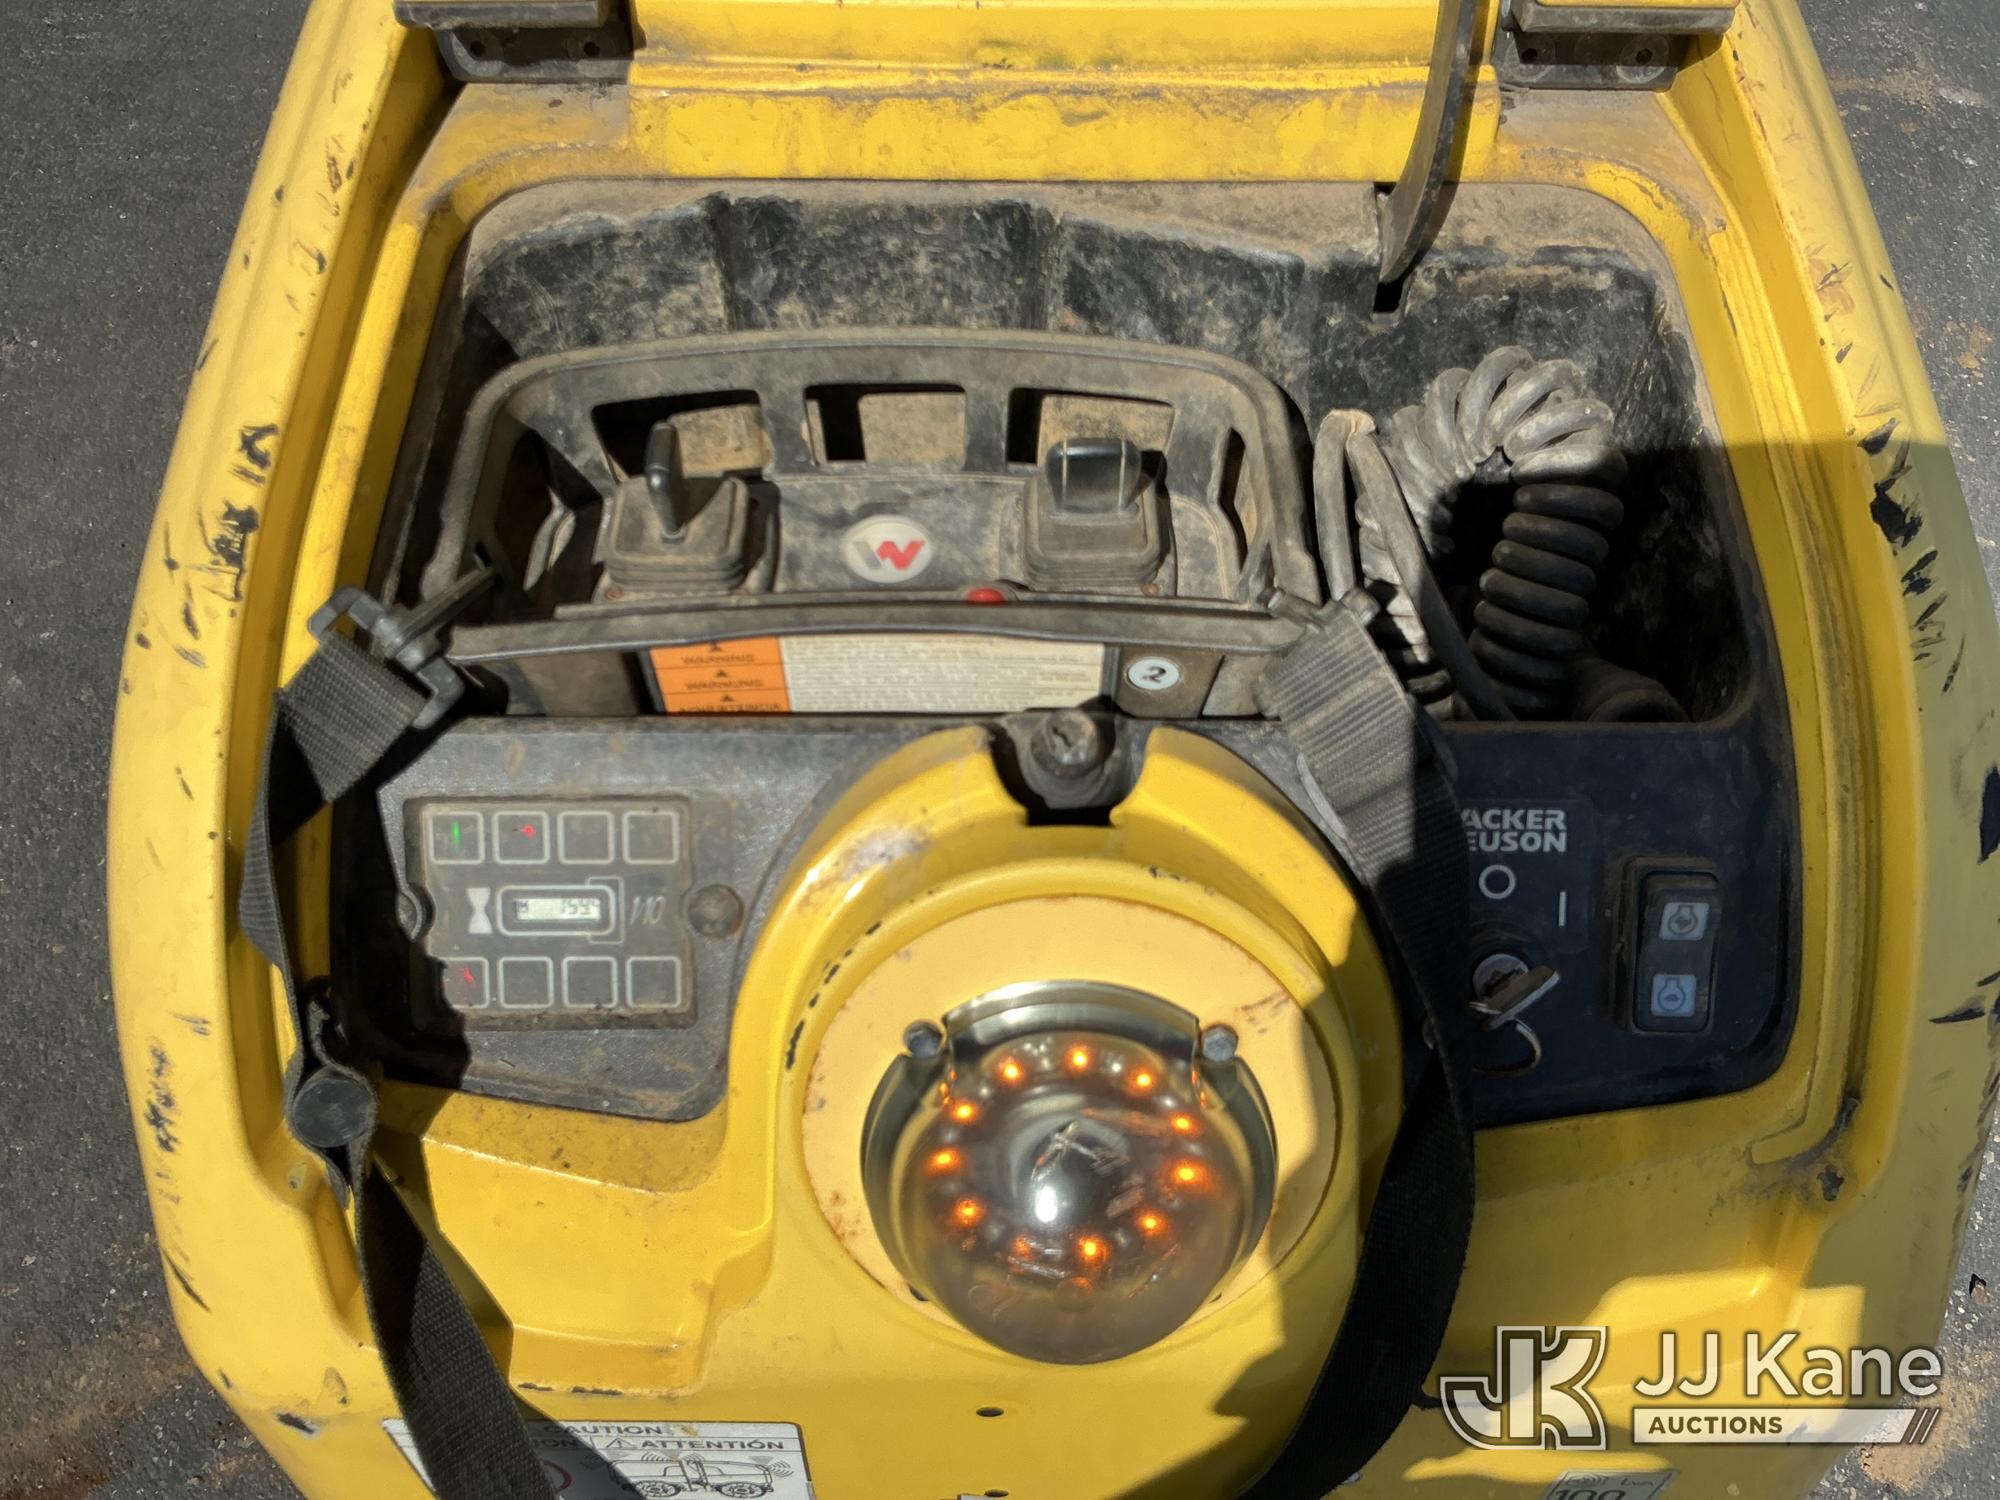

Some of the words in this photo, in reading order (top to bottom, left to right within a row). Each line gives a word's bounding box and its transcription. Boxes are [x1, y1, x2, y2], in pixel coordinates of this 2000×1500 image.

[1142, 666, 1167, 684] 2
[1460, 808, 1567, 830] ACKER
[1466, 831, 1567, 853] EUSON
[543, 1424, 663, 1435] CAUTION
